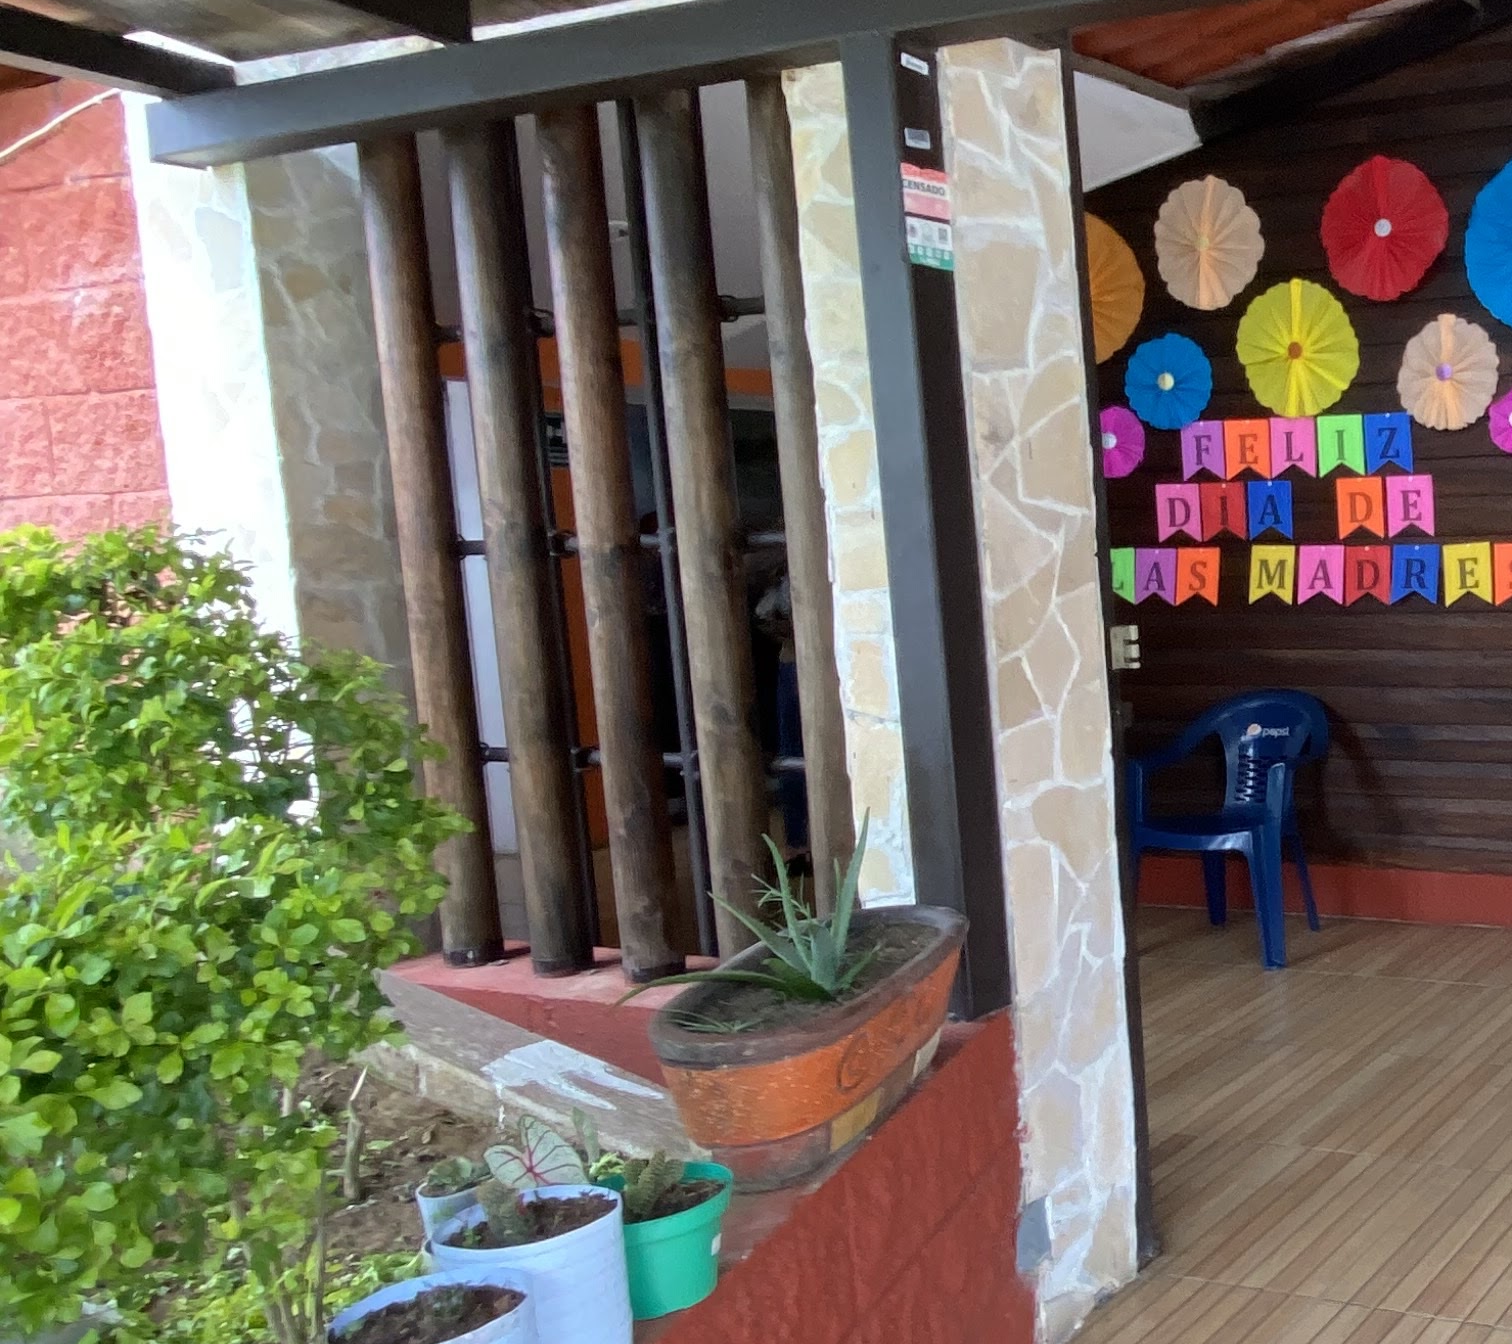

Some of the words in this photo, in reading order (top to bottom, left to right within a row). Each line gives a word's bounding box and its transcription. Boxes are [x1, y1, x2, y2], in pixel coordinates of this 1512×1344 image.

[1193, 427, 1400, 466] FELIZ
[1167, 494, 1283, 528] DIA
[1347, 489, 1422, 524] DE
